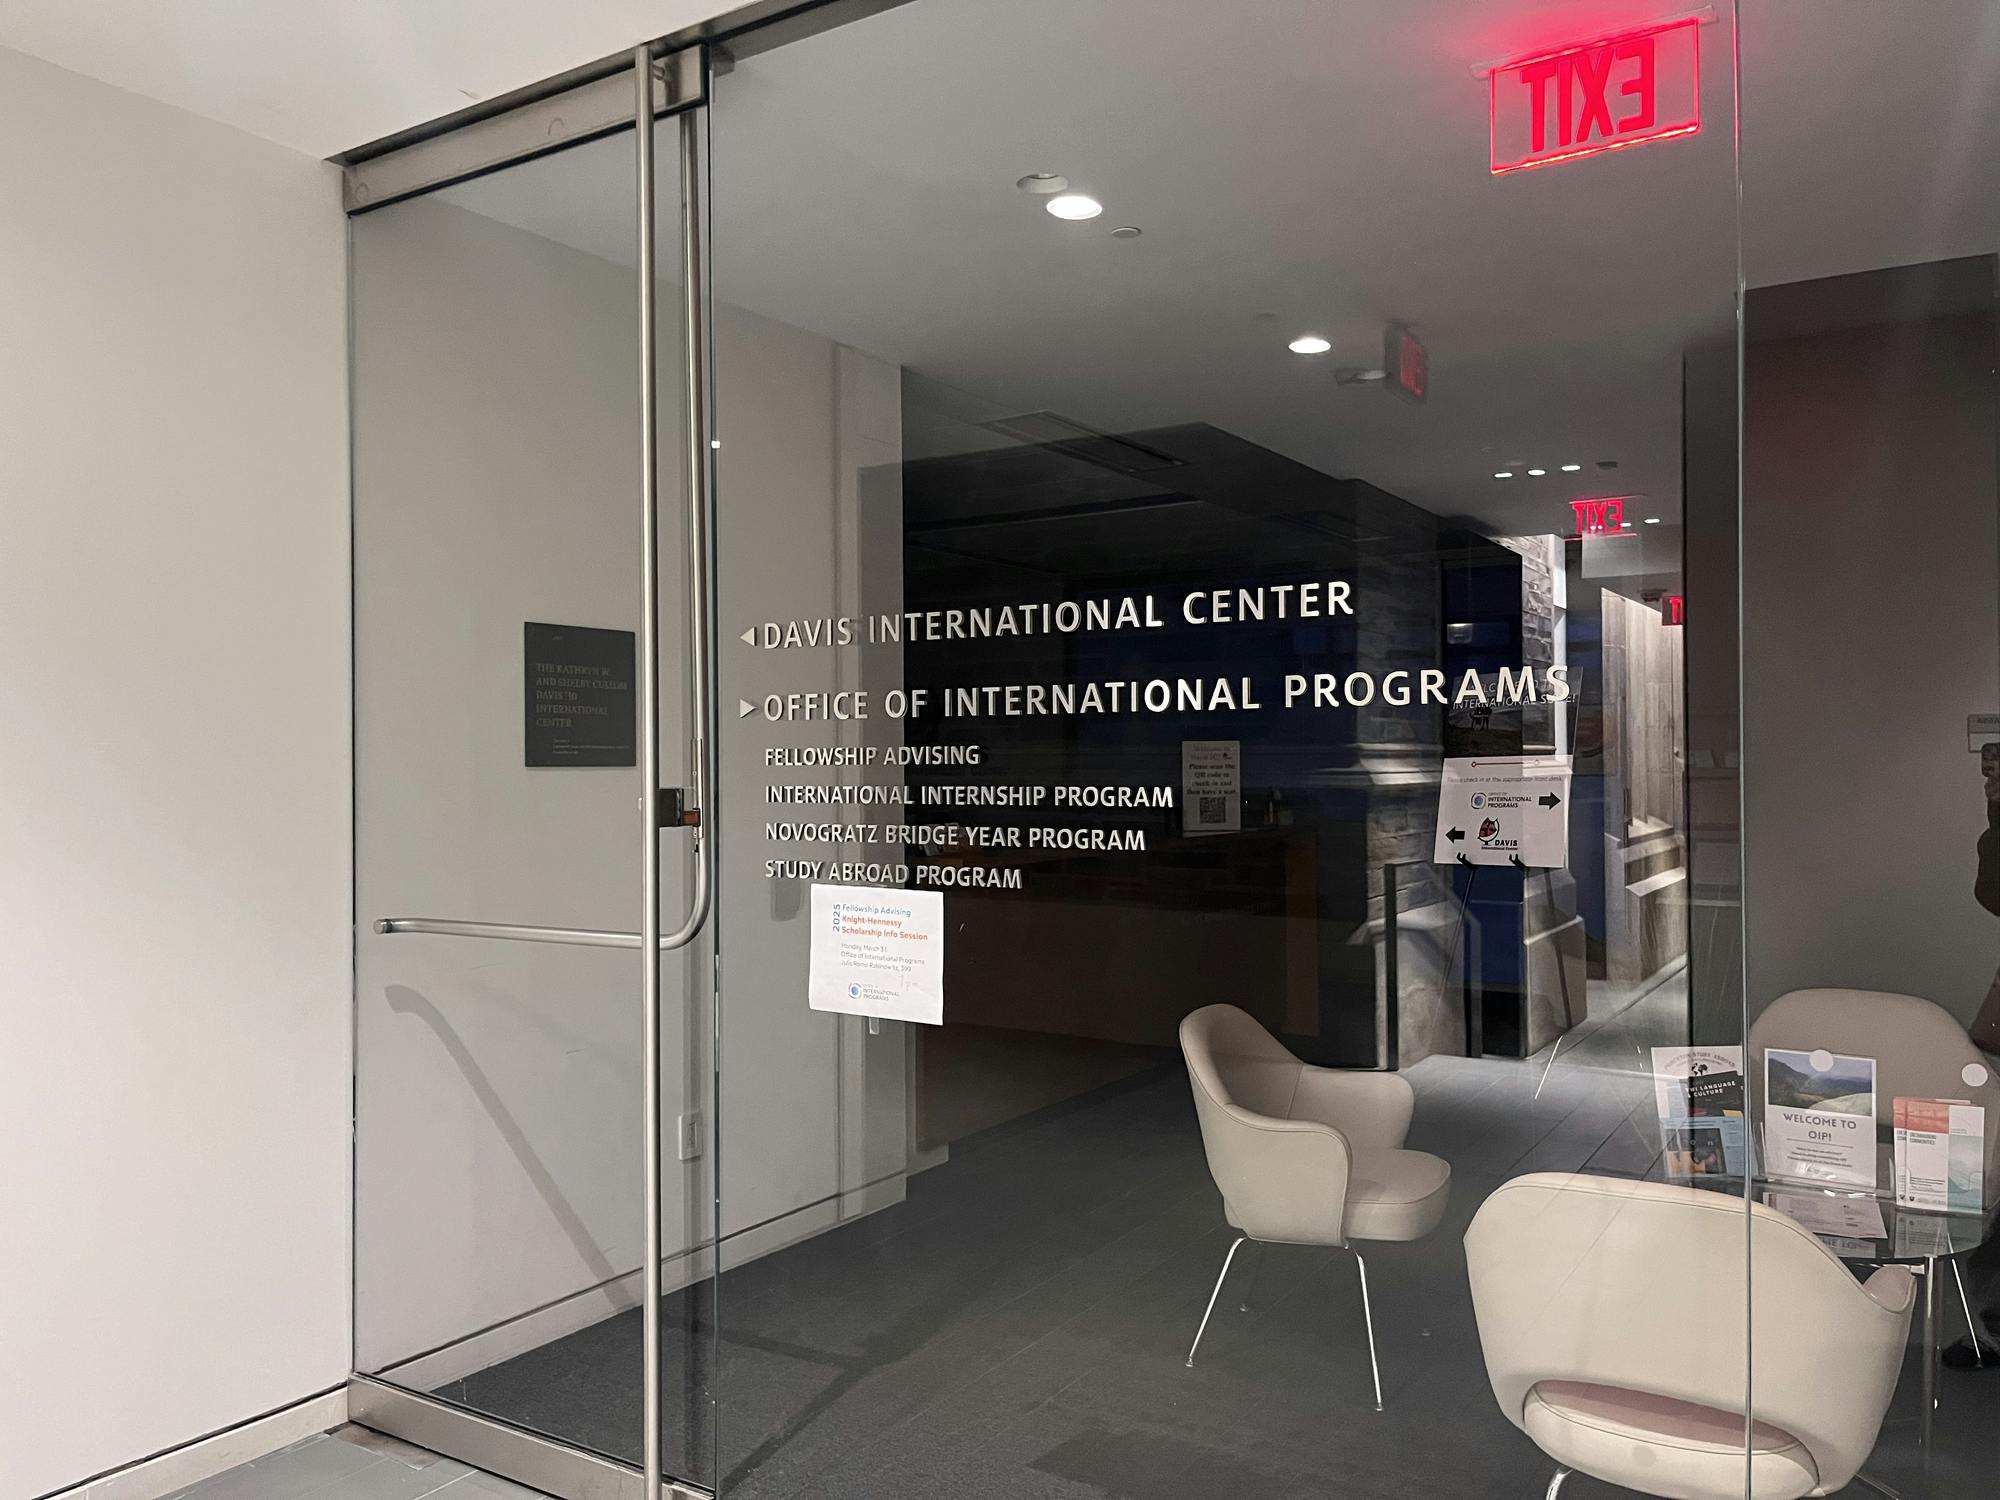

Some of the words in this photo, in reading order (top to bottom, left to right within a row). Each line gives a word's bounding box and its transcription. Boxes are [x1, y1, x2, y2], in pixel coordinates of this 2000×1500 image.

[764, 617, 854, 649] DAVIS
[869, 595, 1164, 644] INTERNATIONAL
[1183, 580, 1354, 625] CENTER
[536, 677, 556, 687] AND
[536, 690, 563, 700] DAVIS
[764, 691, 869, 722] OFFICE
[885, 689, 928, 719] OF
[944, 677, 1262, 717] INTERNATIONAL
[1285, 664, 1570, 709] PROGRAMS
[536, 703, 608, 716] INTERNATIONAL
[536, 717, 572, 727] CENTER
[765, 745, 878, 767] FELLOWSHIP
[883, 744, 982, 766] ADVISING
[765, 784, 916, 805] INTERNATIONAL
[921, 785, 1047, 807] INTERNSHIP
[1054, 785, 1174, 808] PROGRAM
[765, 822, 879, 844] NOVOGRATZ
[885, 824, 960, 846] BRIDGE
[965, 826, 1022, 848] YEAR
[1029, 827, 1147, 851] PROGRAM
[765, 860, 826, 880] STUDY
[828, 862, 912, 884] ABROAD
[916, 864, 1024, 890] PROGRAM
[842, 903, 879, 915] Fellowship
[880, 906, 912, 918] Advising
[832, 904, 842, 932] 2025
[842, 915, 902, 929] Knight-Hennessy
[842, 926, 882, 938] Scholarship
[883, 929, 898, 938] Info
[899, 931, 928, 941] Session
[863, 944, 880, 952] March
[840, 951, 857, 959] Office
[864, 952, 898, 962] International
[898, 957, 925, 966] Programs
[862, 988, 900, 997] INTERNATIONAL
[862, 994, 890, 1002] PROGRAMS
[1693, 1088, 1723, 1097] CULTURE
[1699, 1080, 1736, 1091] LANGUAGE
[1783, 1113, 1837, 1128] WELCOME
[1840, 1119, 1857, 1129] TO
[1808, 1130, 1832, 1142] OIP!
